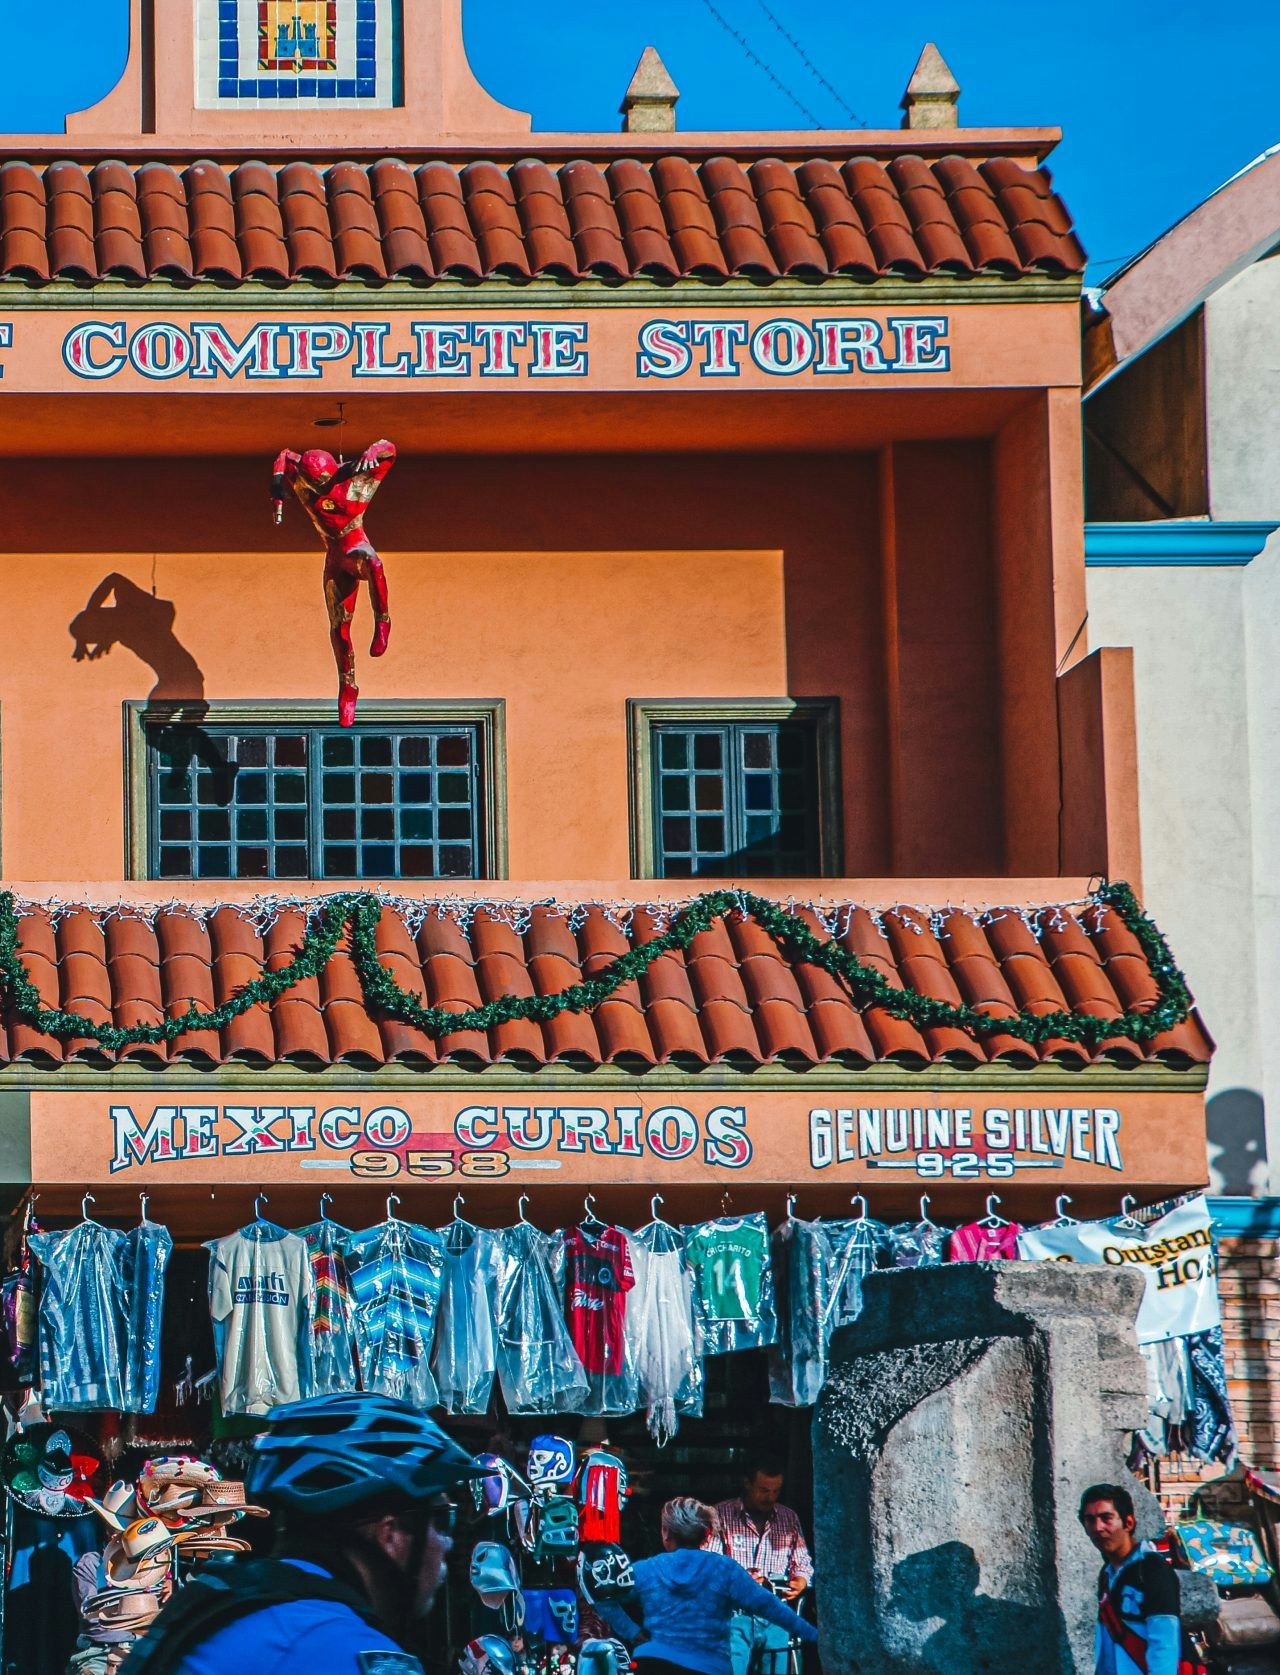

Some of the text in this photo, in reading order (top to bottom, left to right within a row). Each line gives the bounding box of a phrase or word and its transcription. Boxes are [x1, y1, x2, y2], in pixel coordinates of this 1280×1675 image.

[61, 321, 588, 379] COMPLETE
[637, 316, 950, 378] STORE
[109, 1105, 753, 1174] MEXICO CURIOS
[349, 1149, 510, 1178] 958
[809, 1108, 1124, 1171] GENUINE SILVER
[916, 1152, 1015, 1178] 925
